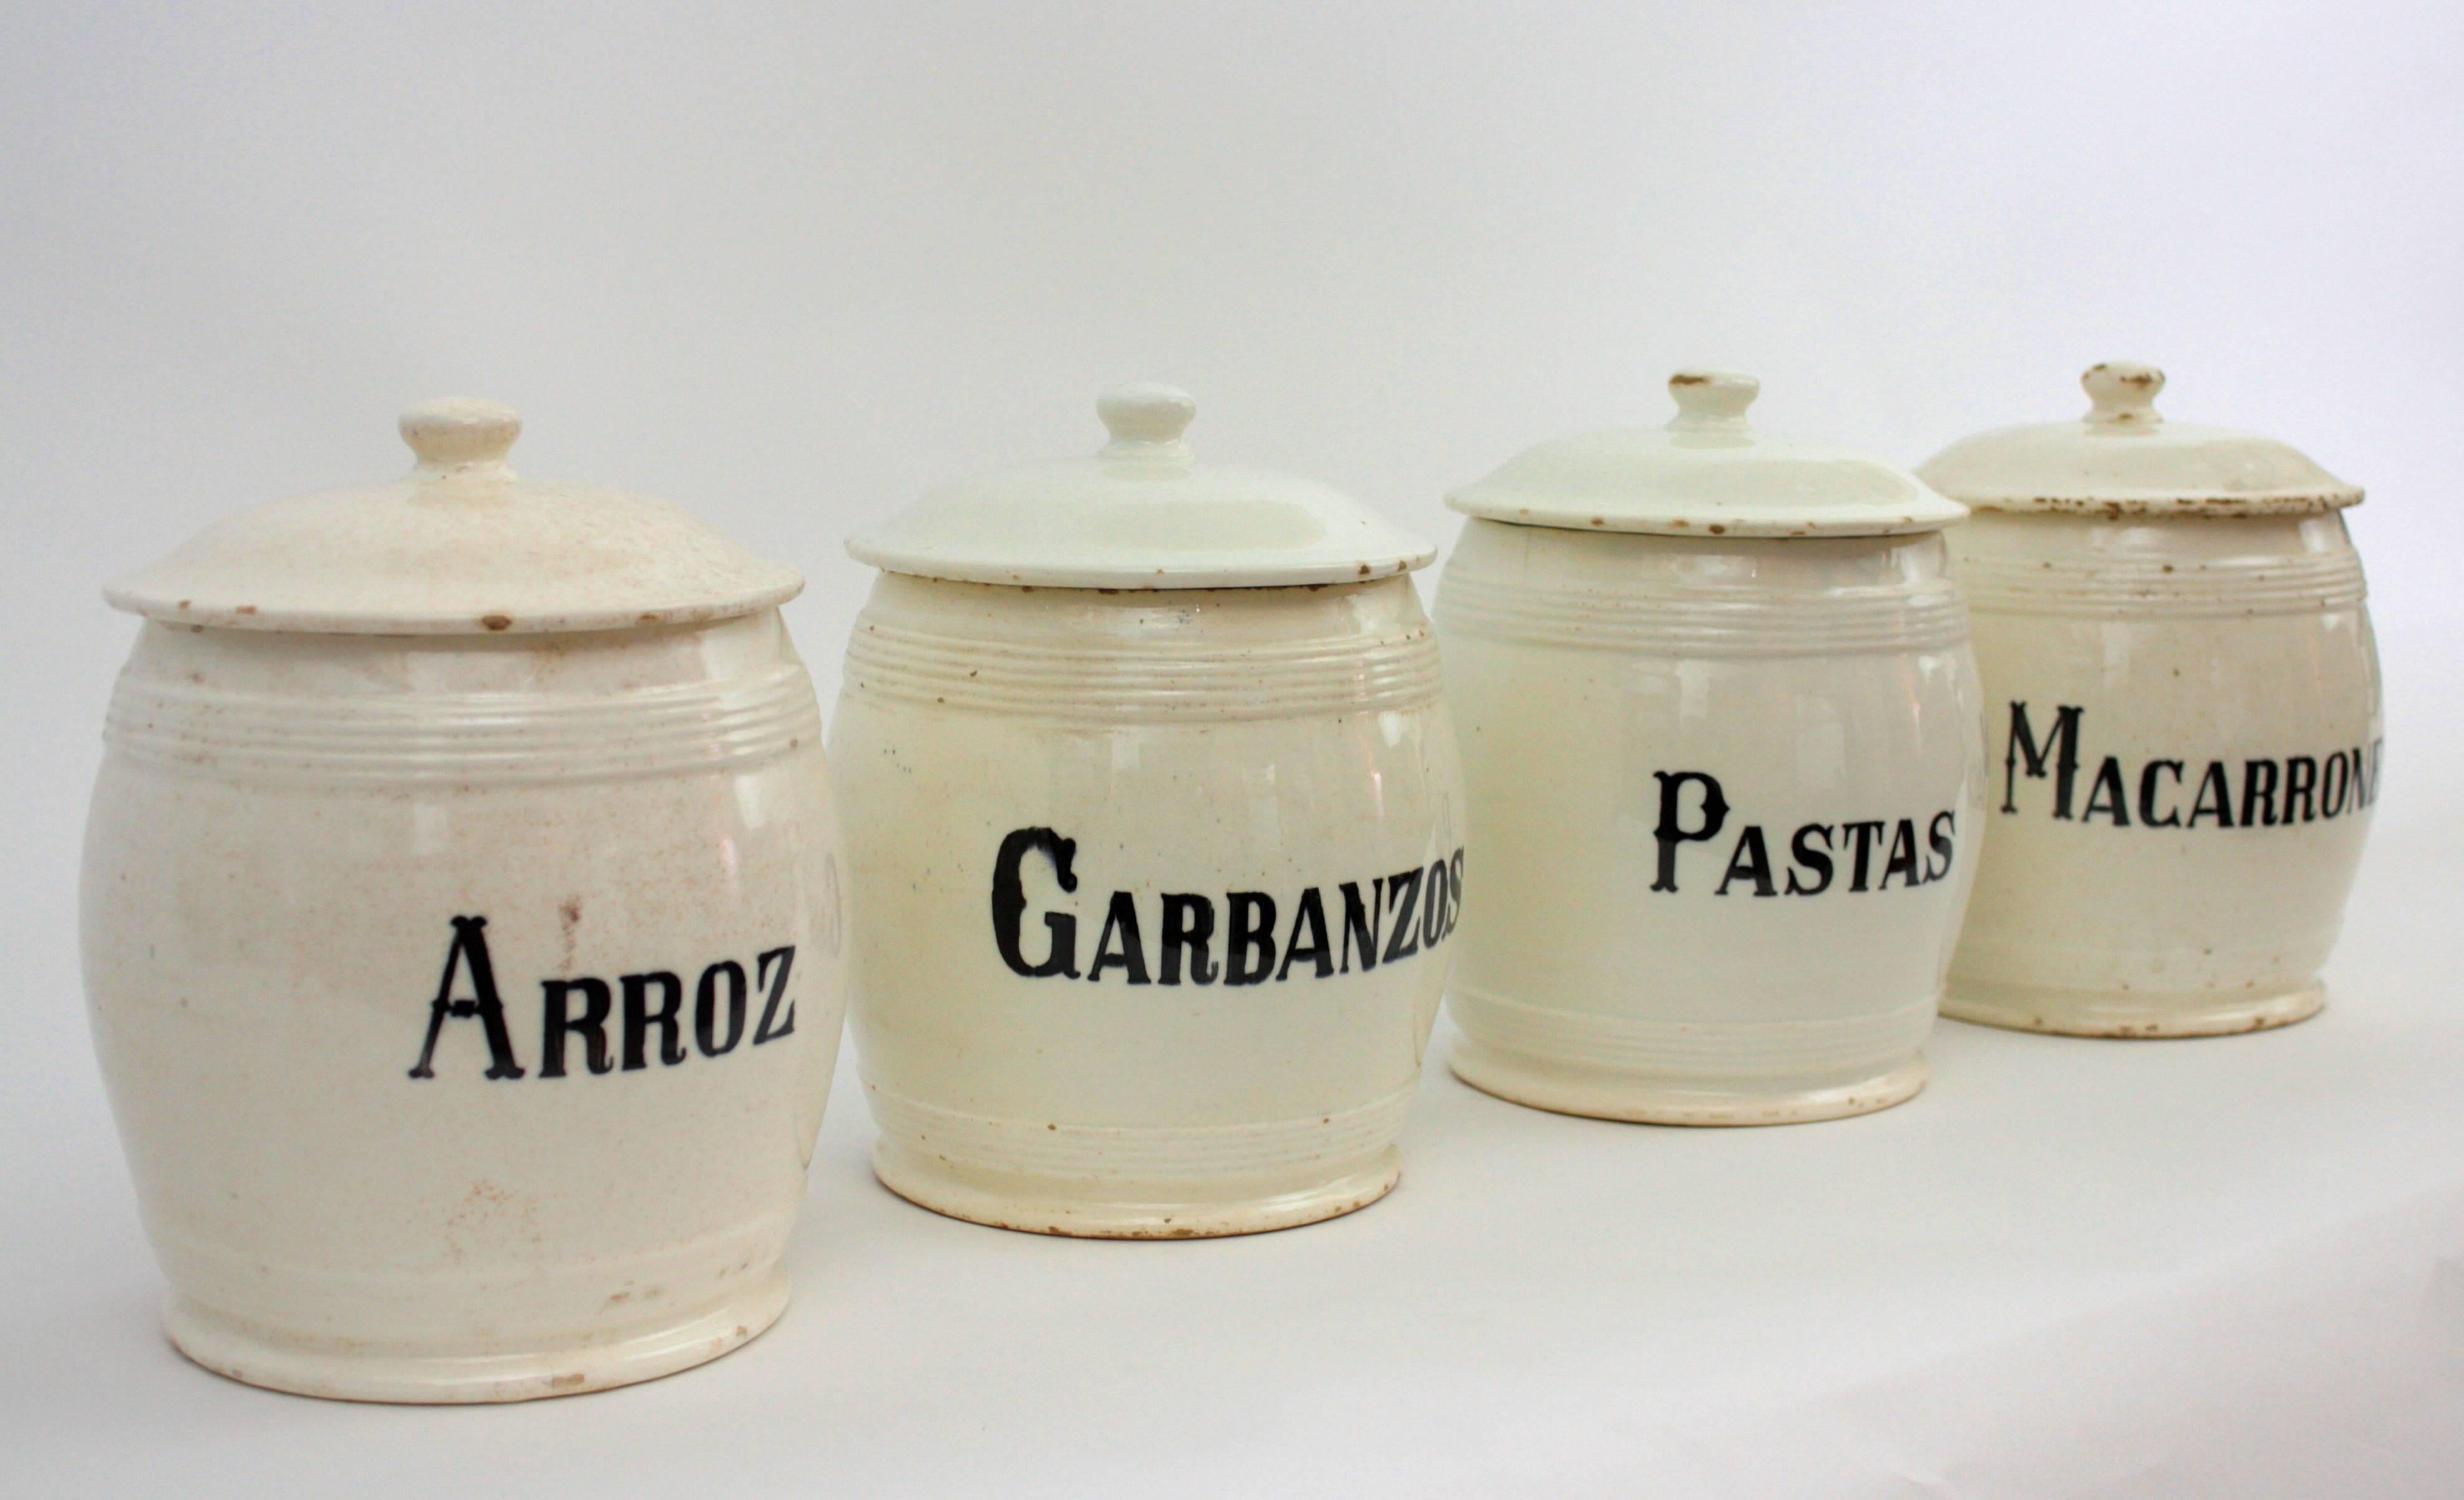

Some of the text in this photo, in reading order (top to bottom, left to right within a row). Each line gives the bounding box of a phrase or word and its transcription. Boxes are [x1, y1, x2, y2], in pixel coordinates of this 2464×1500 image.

[990, 825, 1465, 987] GARBANZOS
[1649, 770, 1956, 898] PASTAS
[407, 914, 796, 1081] ARROZ
